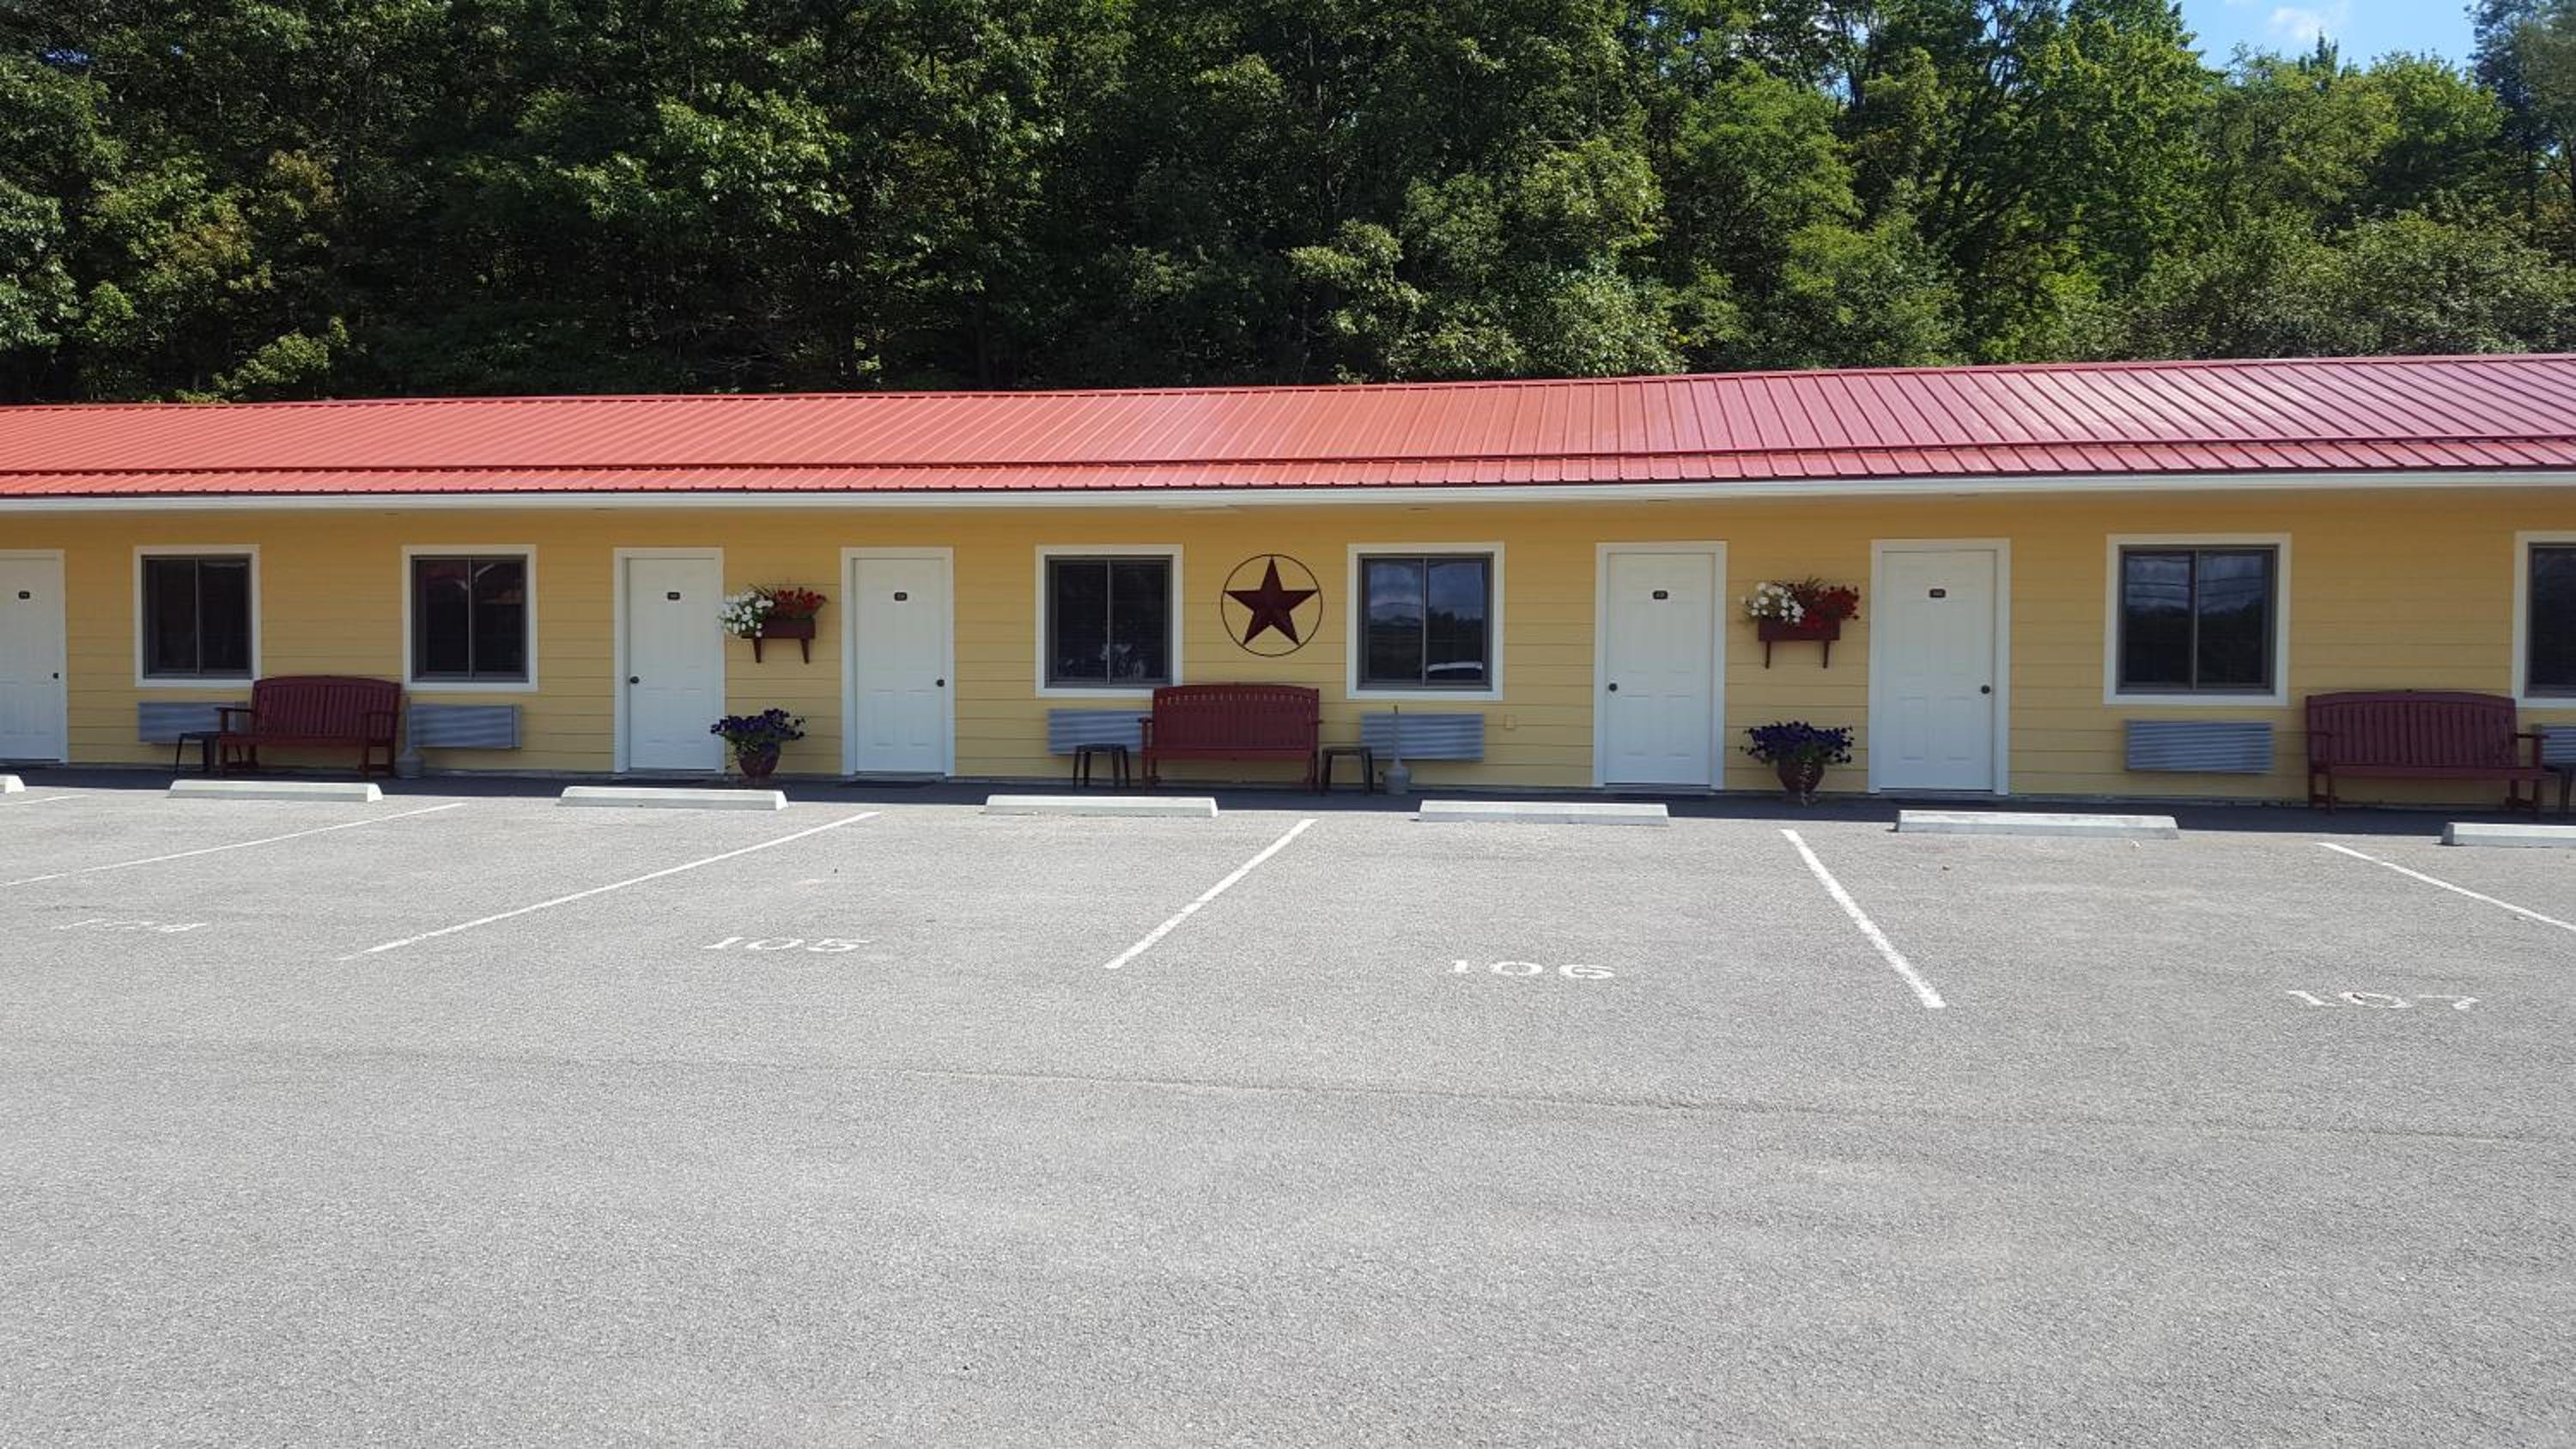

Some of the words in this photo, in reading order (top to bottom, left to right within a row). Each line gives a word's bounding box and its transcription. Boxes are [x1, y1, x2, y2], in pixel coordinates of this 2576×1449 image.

[703, 937, 878, 952] 105
[1448, 959, 1615, 979] 106
[2287, 990, 2480, 1010] 107
